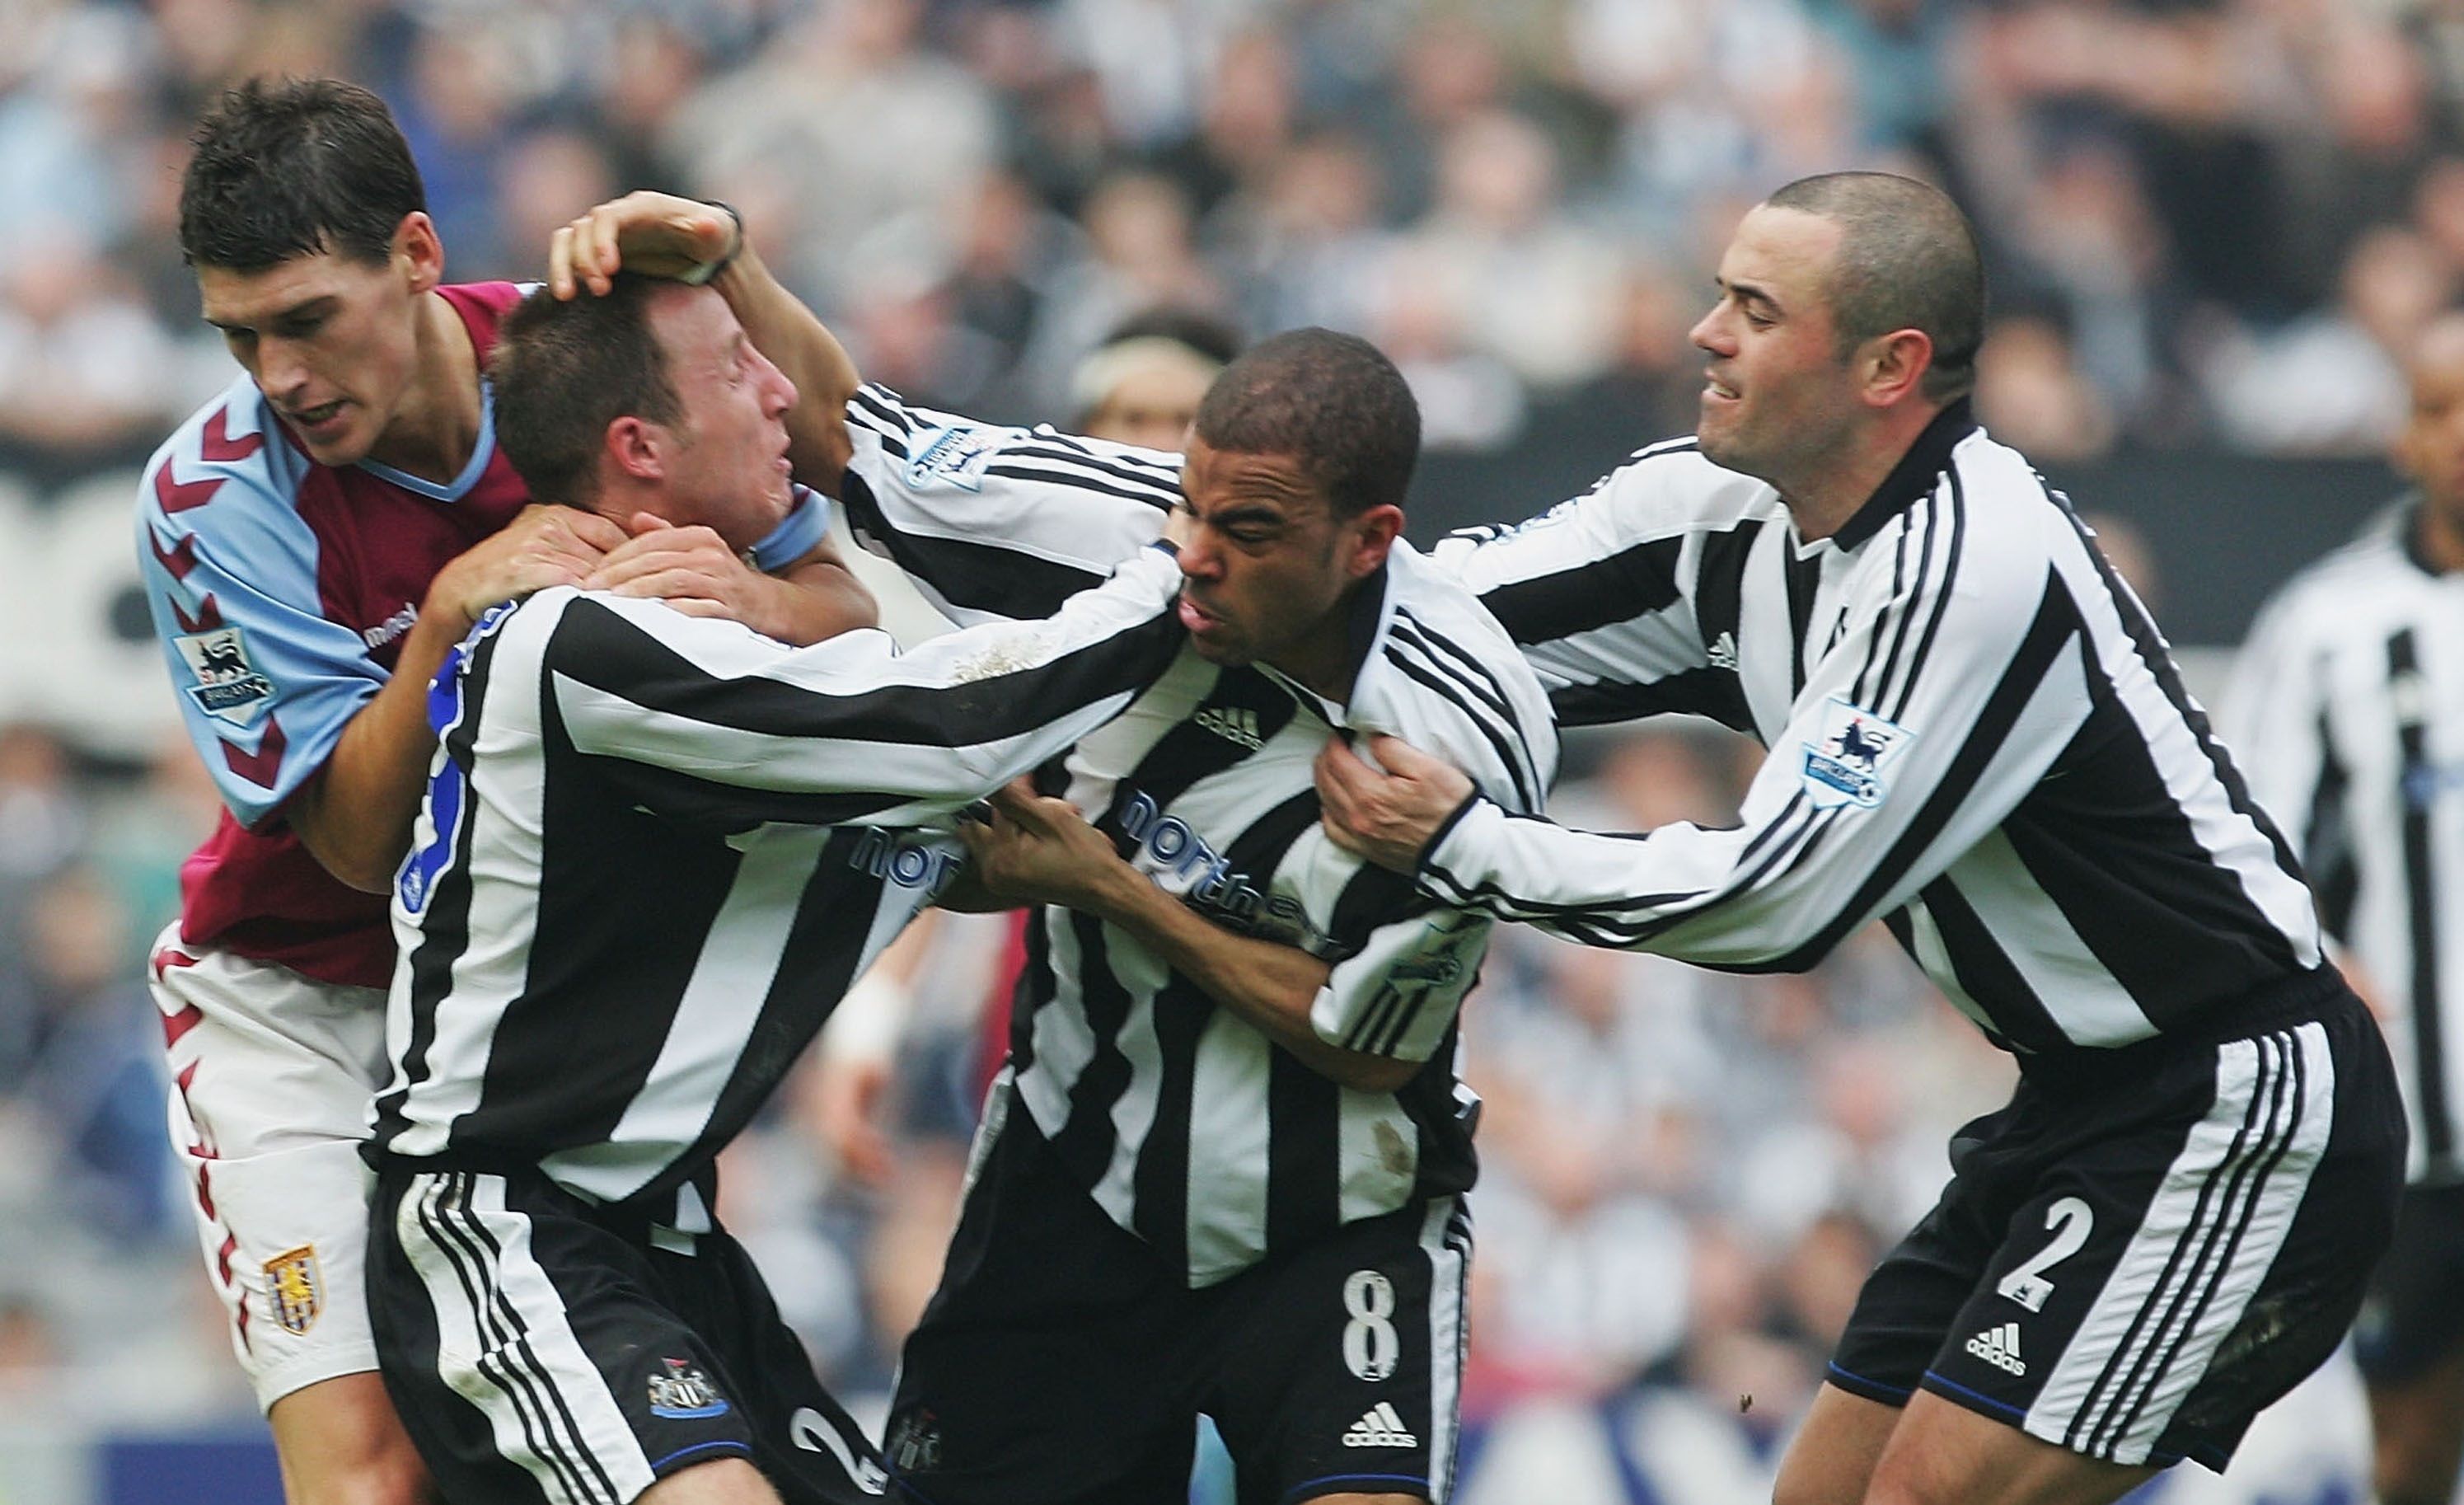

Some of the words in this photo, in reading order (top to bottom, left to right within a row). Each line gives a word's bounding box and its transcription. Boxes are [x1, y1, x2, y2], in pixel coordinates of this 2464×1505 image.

[1194, 710, 1265, 752] adidas
[1998, 1197, 2094, 1314] 2
[1342, 1269, 1400, 1382] 8
[1965, 1338, 2026, 1377] adidas
[1342, 1432, 1418, 1448] adidas
